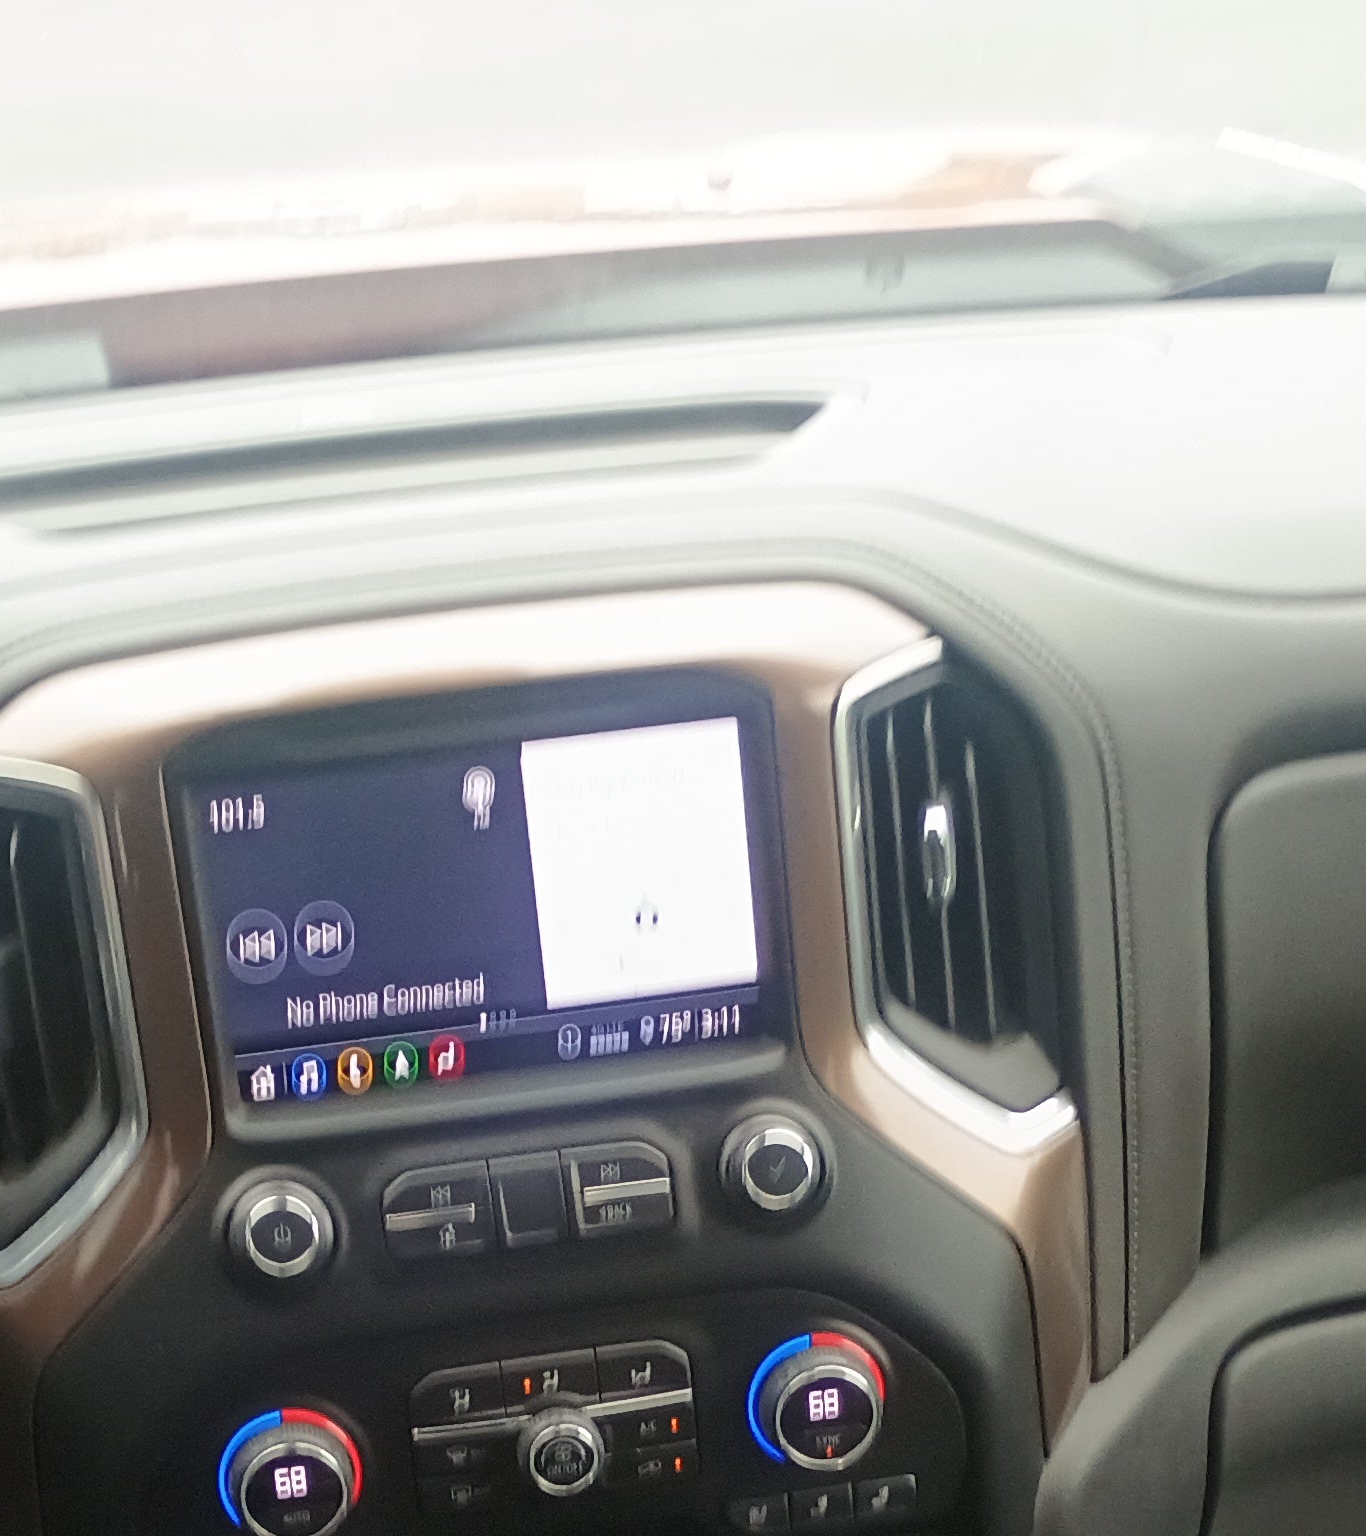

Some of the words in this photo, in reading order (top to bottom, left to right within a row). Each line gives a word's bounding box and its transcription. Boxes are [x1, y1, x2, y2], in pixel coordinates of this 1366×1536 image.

[286, 997, 314, 1029] No
[319, 990, 378, 1024] Phone
[383, 971, 485, 1016] Connected
[808, 1388, 839, 1422] 68
[274, 1465, 308, 1500] 68
